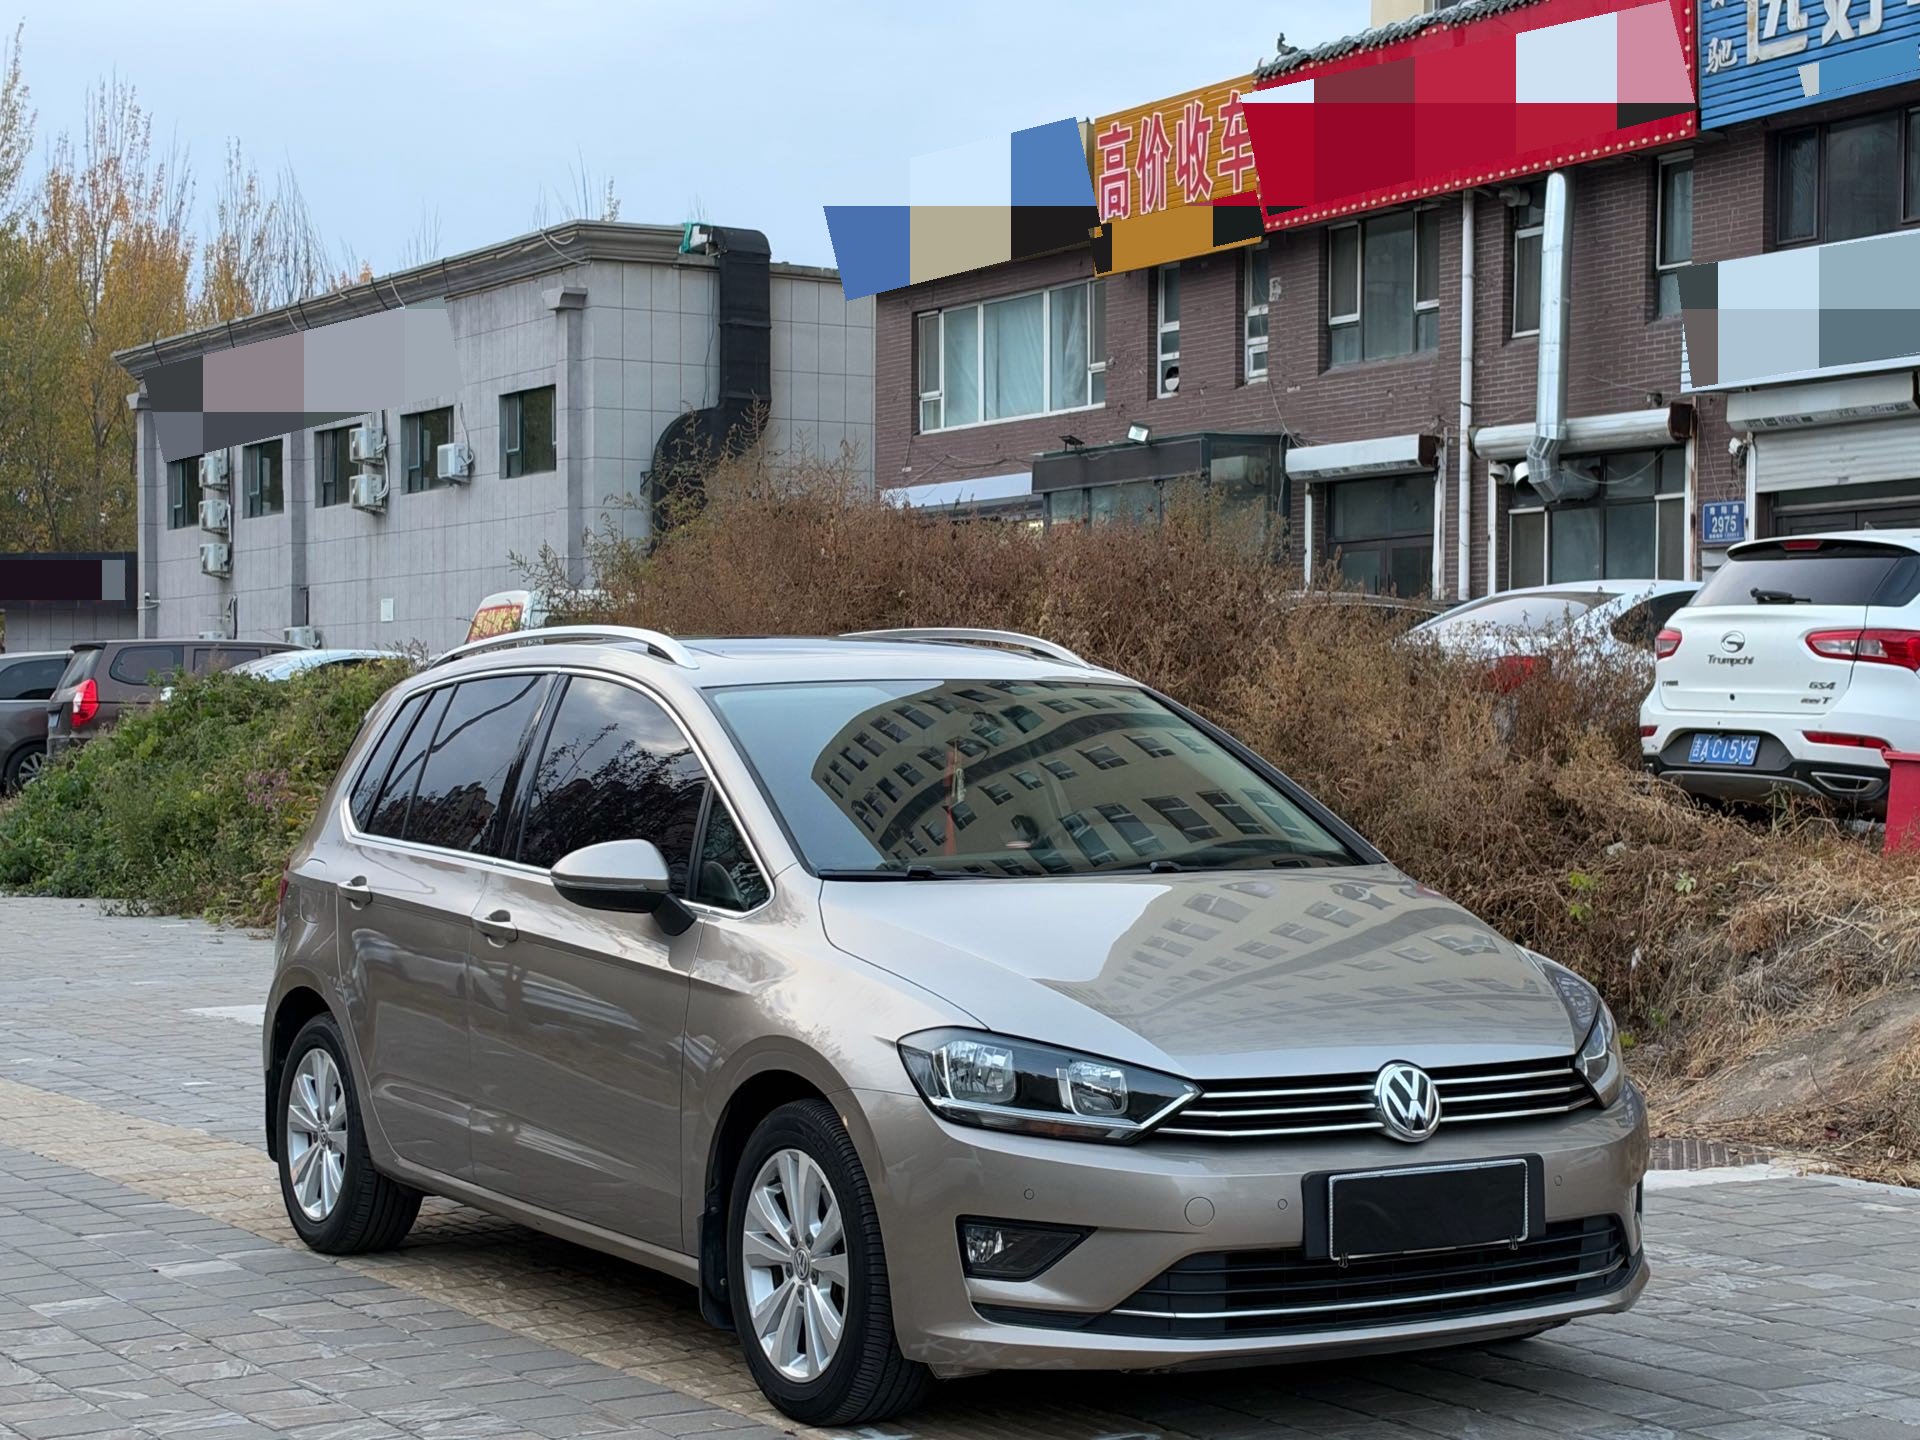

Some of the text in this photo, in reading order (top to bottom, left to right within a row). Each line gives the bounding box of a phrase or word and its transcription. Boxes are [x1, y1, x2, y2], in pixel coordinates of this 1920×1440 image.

[1097, 90, 1256, 224] 高价收车
[1711, 515, 1737, 534] 2975
